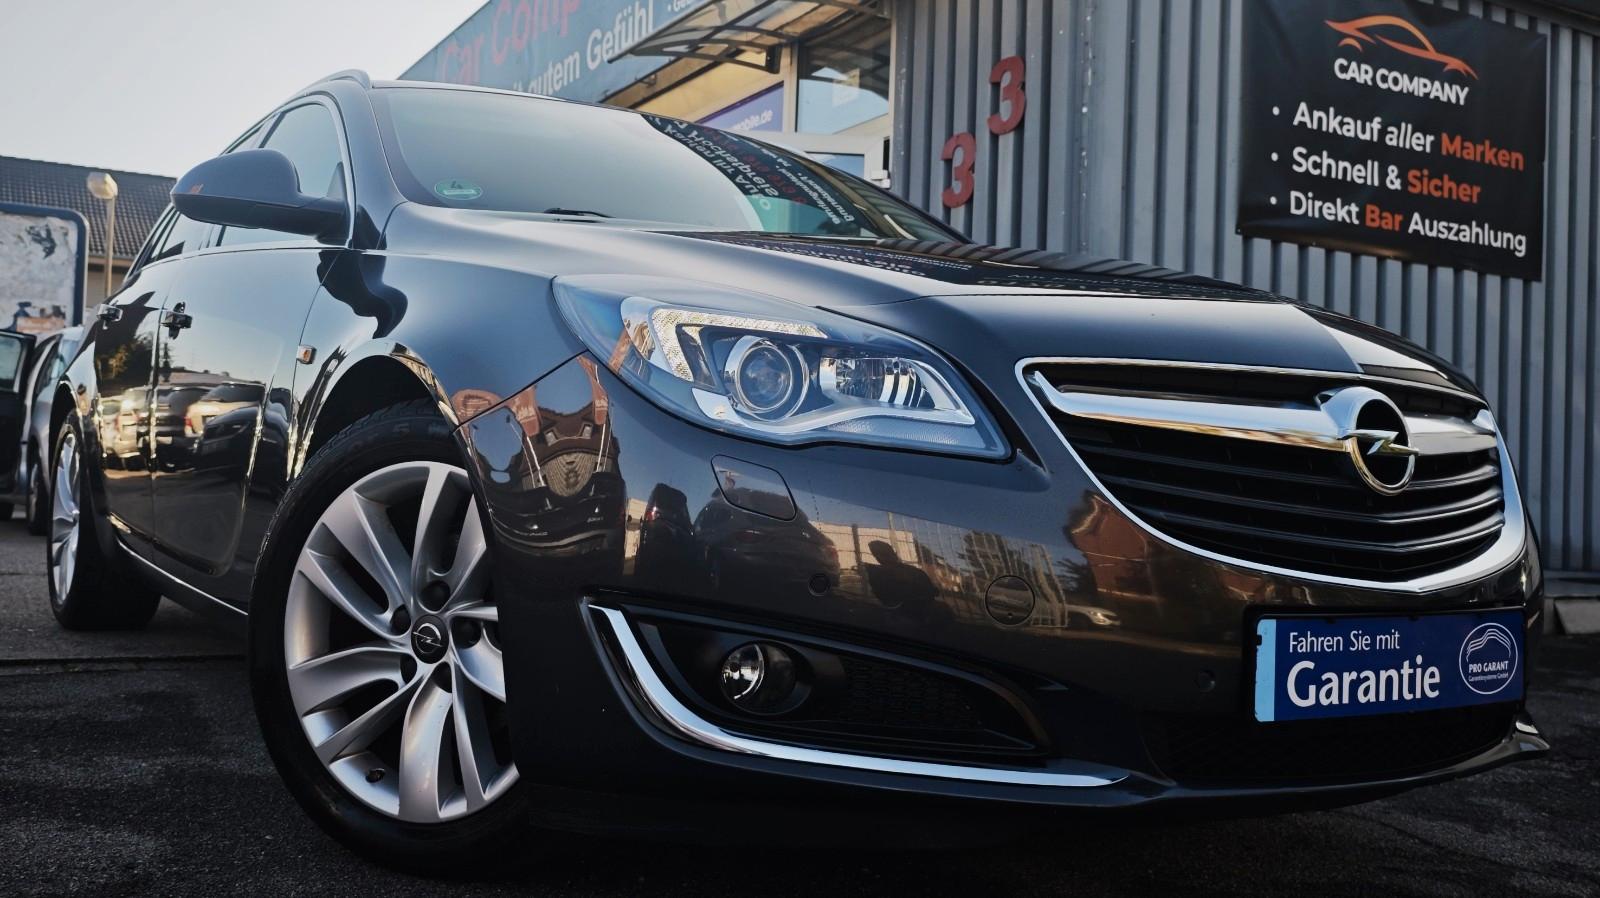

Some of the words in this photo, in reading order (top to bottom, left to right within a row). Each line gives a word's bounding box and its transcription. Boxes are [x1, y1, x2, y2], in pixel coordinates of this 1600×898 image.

[586, 0, 654, 71] Gefühl
[1334, 58, 1373, 86] CAR
[1375, 68, 1469, 105] COMPANY
[1293, 102, 1382, 143] Ankauf
[1385, 122, 1435, 153] aller
[1441, 133, 1525, 171] Marken
[1292, 147, 1379, 187] Schnell
[1386, 165, 1402, 190] &
[1408, 169, 1481, 204] Sicher
[1290, 191, 1359, 225] Direkt
[1365, 204, 1403, 231] Bar
[1408, 212, 1527, 257] Auszahlung
[1289, 631, 1343, 653] Fahren
[1350, 630, 1371, 651] Sie
[1376, 629, 1400, 650] mit
[1468, 663, 1482, 673] PRO
[1483, 660, 1509, 672] GARANT
[1287, 654, 1441, 708] Garantie
